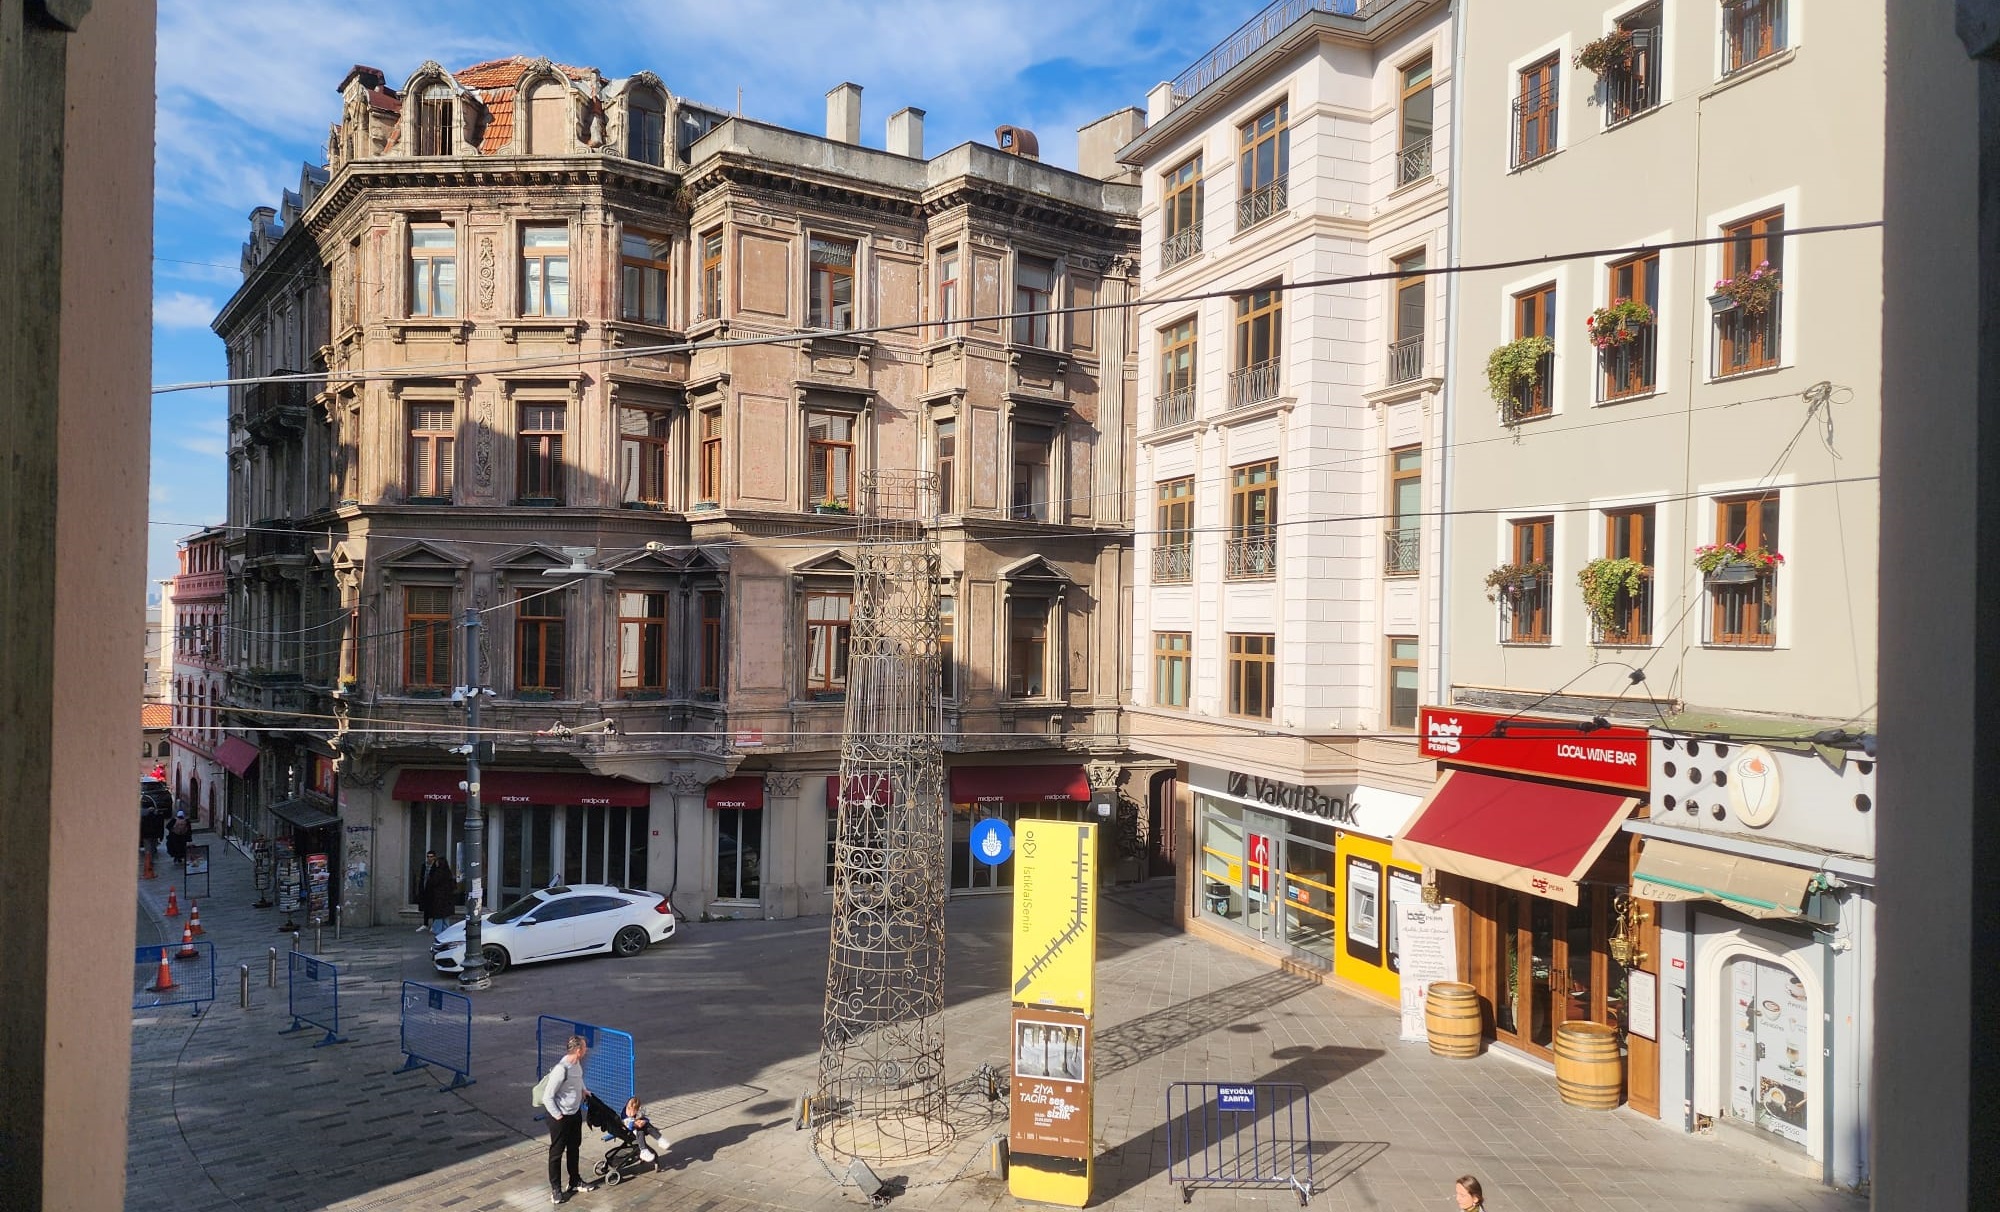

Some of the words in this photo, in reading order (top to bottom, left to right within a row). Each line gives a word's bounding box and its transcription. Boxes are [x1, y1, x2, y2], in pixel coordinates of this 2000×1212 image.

[1557, 744, 1587, 760] LOCAL
[1586, 747, 1615, 763] WINE
[1615, 750, 1637, 766] BAR
